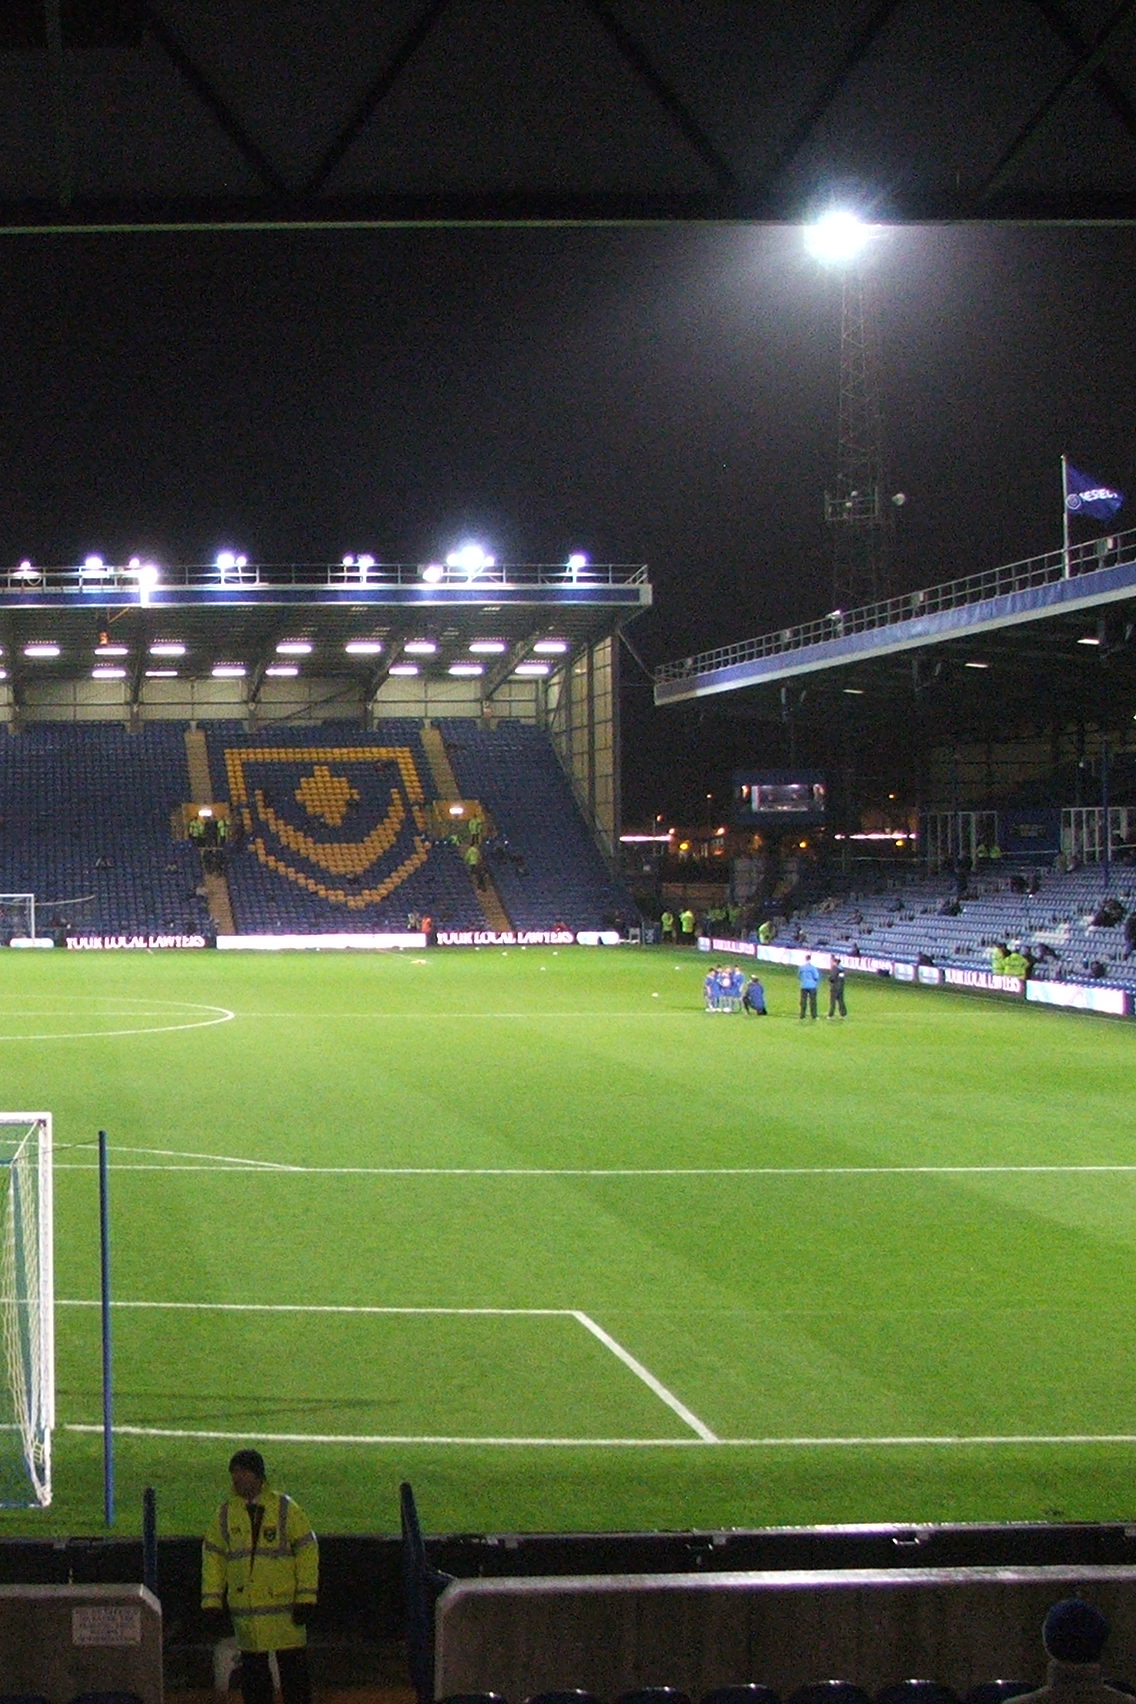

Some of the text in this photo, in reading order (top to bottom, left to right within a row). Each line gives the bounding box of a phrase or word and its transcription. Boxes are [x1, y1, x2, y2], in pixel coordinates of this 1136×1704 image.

[104, 936, 147, 948] LOCAL
[148, 935, 205, 947] LAWYERS
[474, 931, 516, 943] LOCAL
